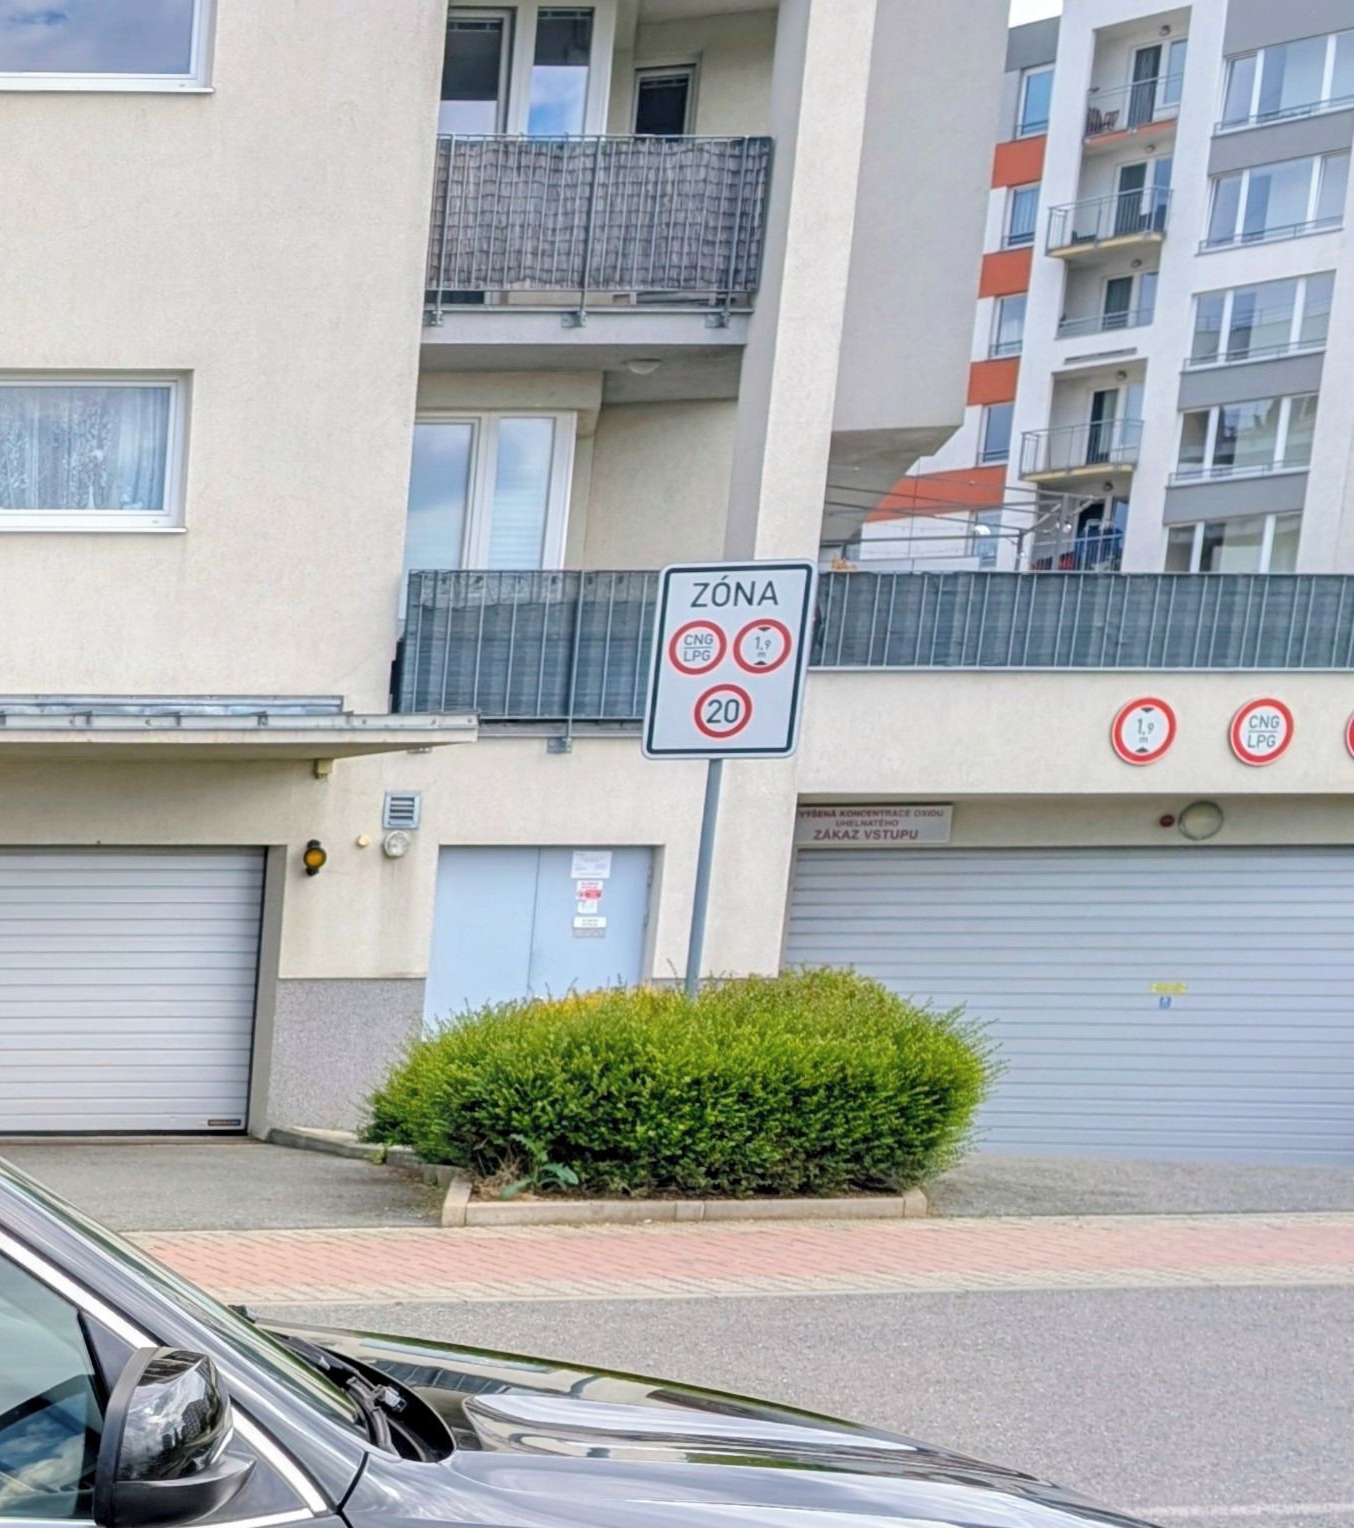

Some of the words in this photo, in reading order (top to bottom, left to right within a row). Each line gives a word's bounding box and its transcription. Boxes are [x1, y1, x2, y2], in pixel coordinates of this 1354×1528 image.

[690, 575, 779, 608] ZÓNA
[684, 633, 713, 646] CNG
[683, 650, 711, 662] LPG
[706, 699, 740, 724] 20
[1248, 715, 1280, 729] CNG
[1247, 734, 1276, 748] LPG
[839, 809, 910, 818] KONCENTRACE
[914, 809, 944, 817] OXIDU
[813, 828, 860, 841] ZÁKAZ
[865, 829, 919, 840] VSTUPU
